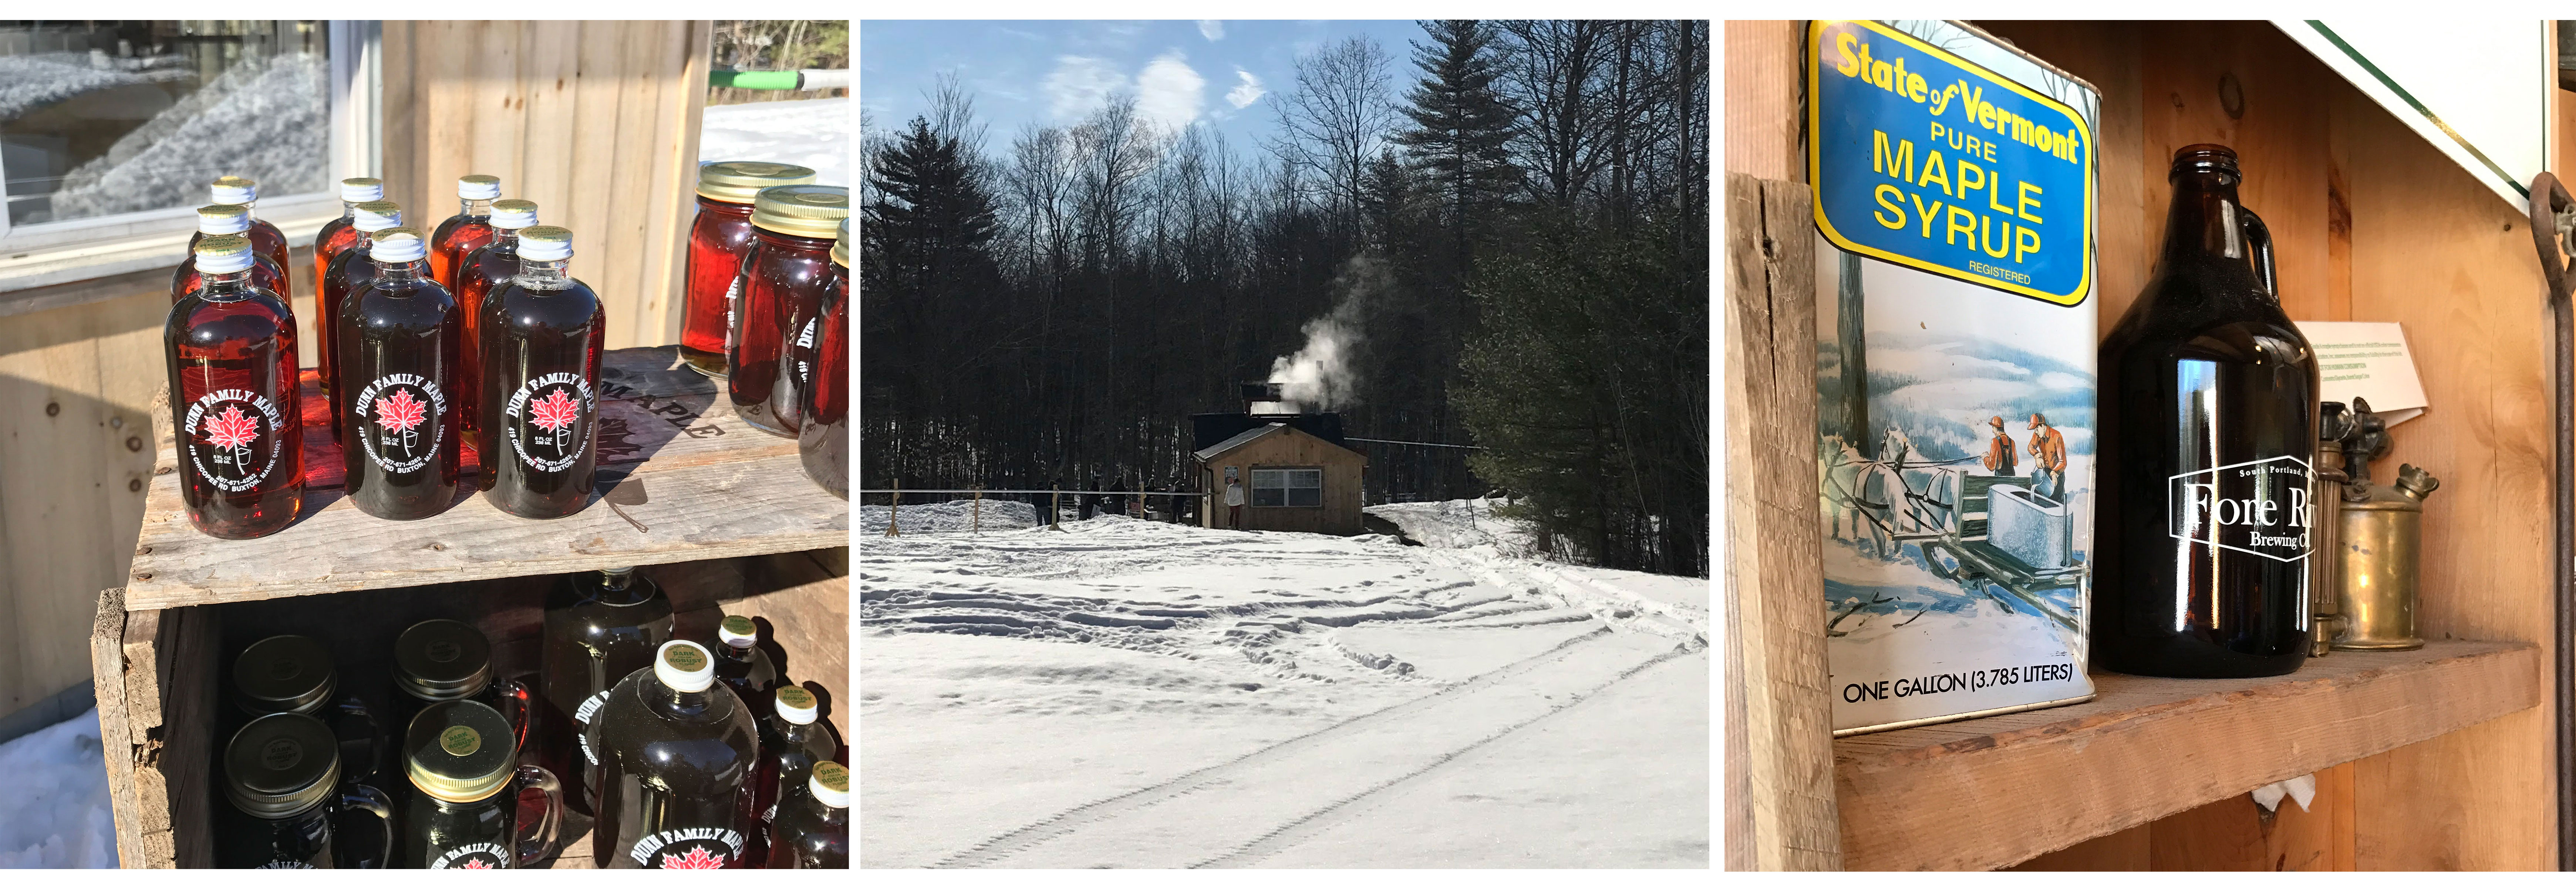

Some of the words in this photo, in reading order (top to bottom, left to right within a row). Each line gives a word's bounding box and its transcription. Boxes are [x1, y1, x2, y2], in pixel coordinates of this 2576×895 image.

[1836, 32, 1928, 103] State
[1929, 84, 1959, 115] of
[1958, 79, 2079, 164] Vermont
[1931, 121, 1997, 163] PURE
[1874, 129, 2043, 225] MAPLE
[1874, 184, 2041, 264] SYRUP
[1969, 260, 2031, 285] REGISTERED
[356, 385, 377, 417] DUNN
[372, 373, 424, 391] FAMILY
[422, 380, 447, 416] MAPLE
[506, 387, 532, 418] DUNN
[528, 372, 579, 391] FAMILY
[576, 378, 595, 413] MAPLE
[601, 381, 726, 438] MAPLE
[185, 403, 205, 435] DUNN
[199, 389, 254, 408] FAMILY
[252, 395, 283, 431] MAPLE
[508, 427, 516, 438] 419
[361, 438, 385, 467] CHICOPEE
[397, 461, 426, 474] BUXTON,
[424, 443, 439, 462] MAINE
[436, 424, 445, 442] 04093
[383, 456, 422, 467] 207-671-4262
[511, 438, 536, 467] CHICOPEE
[535, 454, 572, 466] 207-671-4262
[574, 440, 588, 460] MAINE
[193, 456, 217, 486] CHICOPEE
[232, 479, 262, 492] BUXTON,
[260, 459, 276, 479] MAINE
[273, 440, 281, 458] 04093
[216, 473, 257, 485] 207-671-4262
[548, 460, 575, 472] BUXTON,
[2240, 468, 2265, 477] South
[2270, 466, 2303, 477] Portland,
[2184, 484, 2277, 526] Fore
[2249, 531, 2297, 550] Brewing
[1843, 681, 1888, 703] ONE
[1894, 673, 1966, 697] GALLON
[1971, 667, 2019, 692] (3.785
[2023, 663, 2073, 683] LITERS)
[575, 695, 604, 725] DUNN
[448, 737, 475, 748] ROBUST
[449, 732, 468, 741] DARK
[445, 843, 491, 861] FAMILY
[489, 844, 510, 869] MAPLE
[630, 834, 664, 866] DUNN
[660, 828, 724, 844] FAMILY
[721, 830, 744, 861] MAPLE
